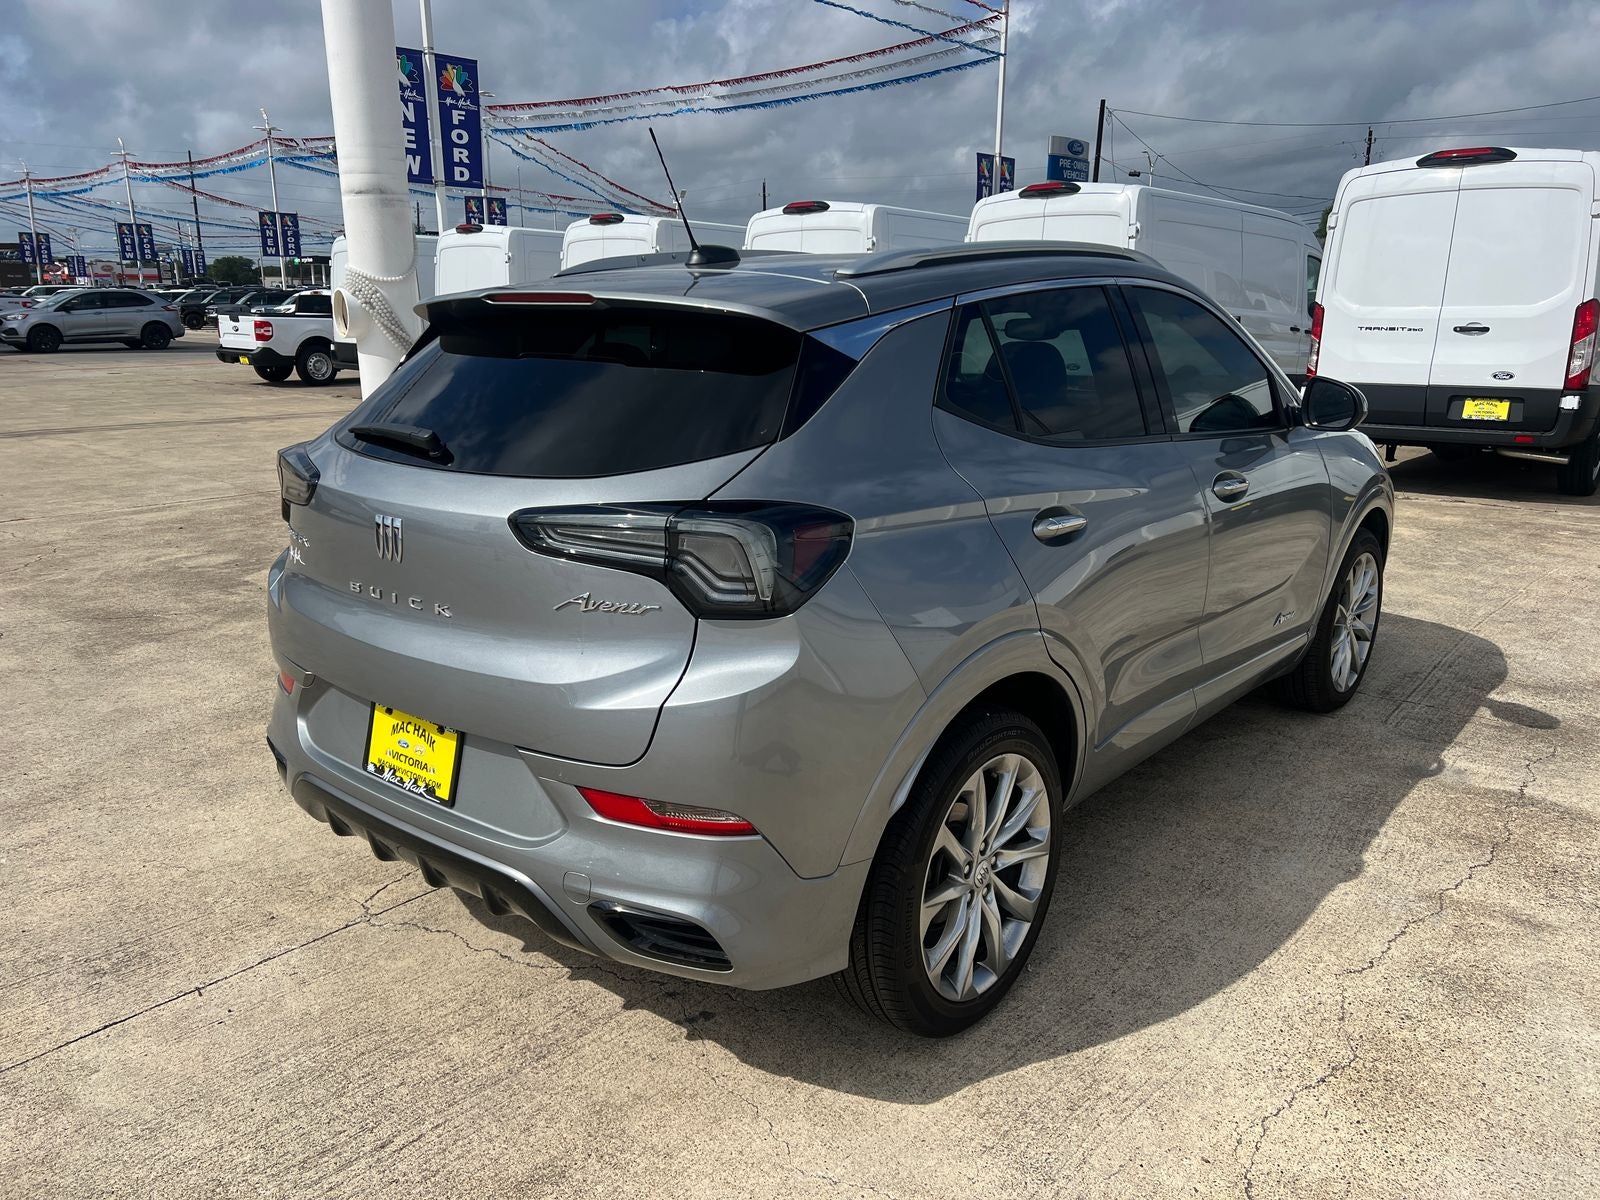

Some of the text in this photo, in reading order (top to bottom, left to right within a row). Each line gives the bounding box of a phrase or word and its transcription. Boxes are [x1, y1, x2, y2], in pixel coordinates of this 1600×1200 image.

[450, 109, 470, 182] FORD
[124, 238, 134, 259] NEW
[143, 238, 152, 260] FORD
[265, 229, 276, 255] NEW
[287, 230, 296, 256] FORD
[24, 245, 33, 263] NEW
[41, 245, 49, 264] FORD
[349, 580, 453, 619] BUICK
[552, 592, 662, 615] Avenir
[390, 721, 412, 737] MAC
[413, 723, 437, 752] HAIK
[391, 749, 429, 773] VICTORIA
[376, 768, 404, 787] Mac
